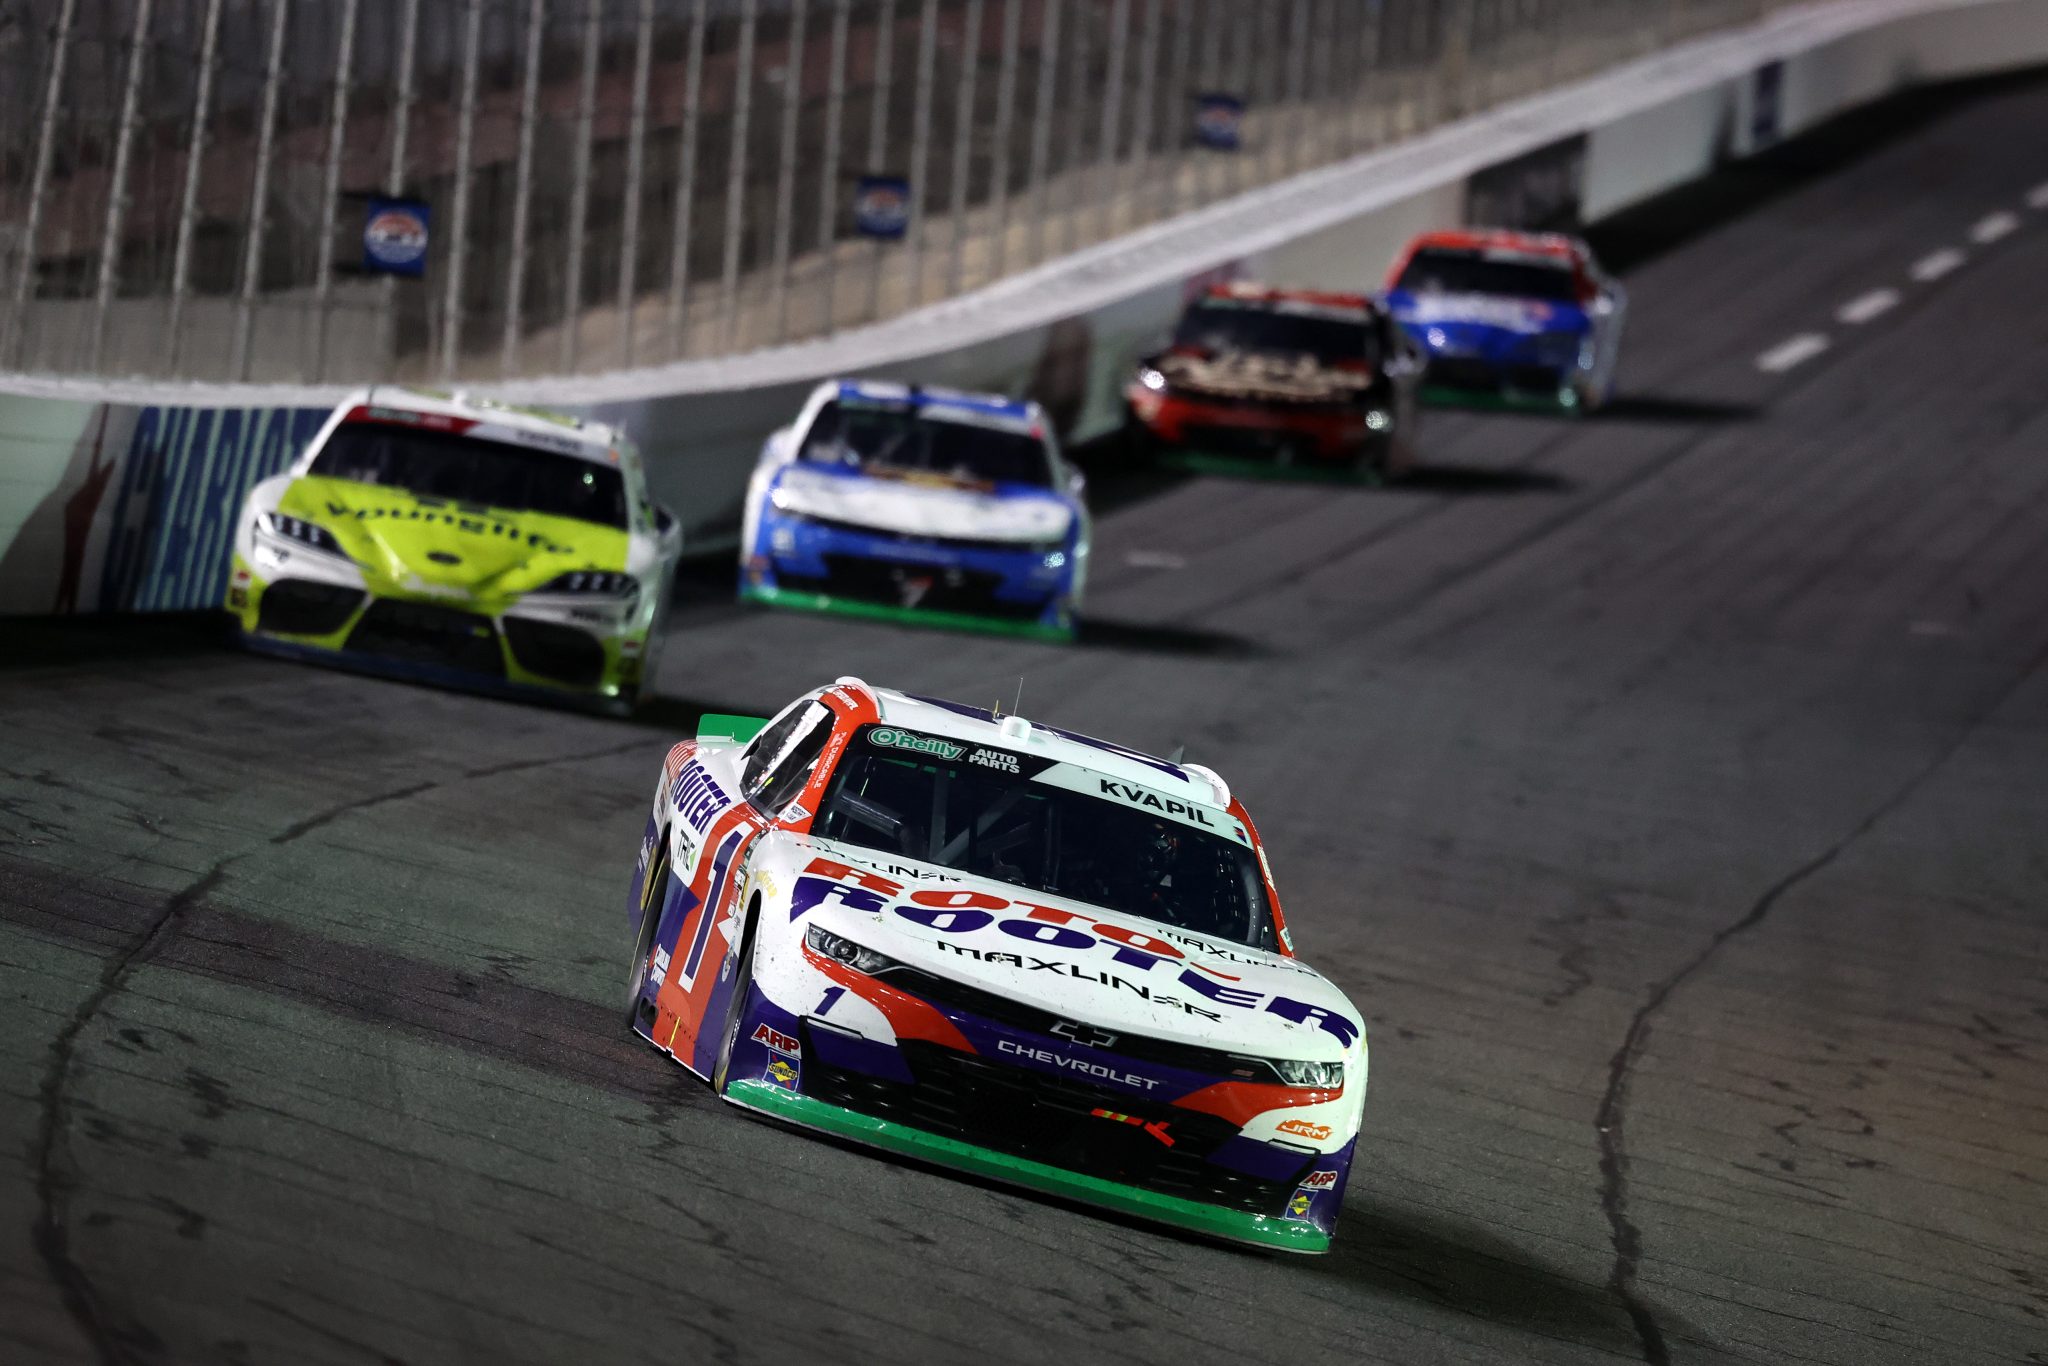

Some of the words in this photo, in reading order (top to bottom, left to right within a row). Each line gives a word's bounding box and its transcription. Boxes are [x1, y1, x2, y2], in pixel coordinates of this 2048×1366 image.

[869, 727, 962, 760] O'Reilly
[976, 748, 1018, 764] AUTO
[968, 754, 1020, 774] PARTS
[1100, 778, 1215, 827] KVAPIL
[680, 825, 751, 989] 1
[789, 876, 1360, 1049] ROOTER
[814, 986, 846, 1016] 1
[753, 1024, 800, 1054] ARP
[769, 1063, 798, 1081] SUNOCO
[997, 1040, 1160, 1091] CHEVROLET
[1281, 1124, 1328, 1138] JRM
